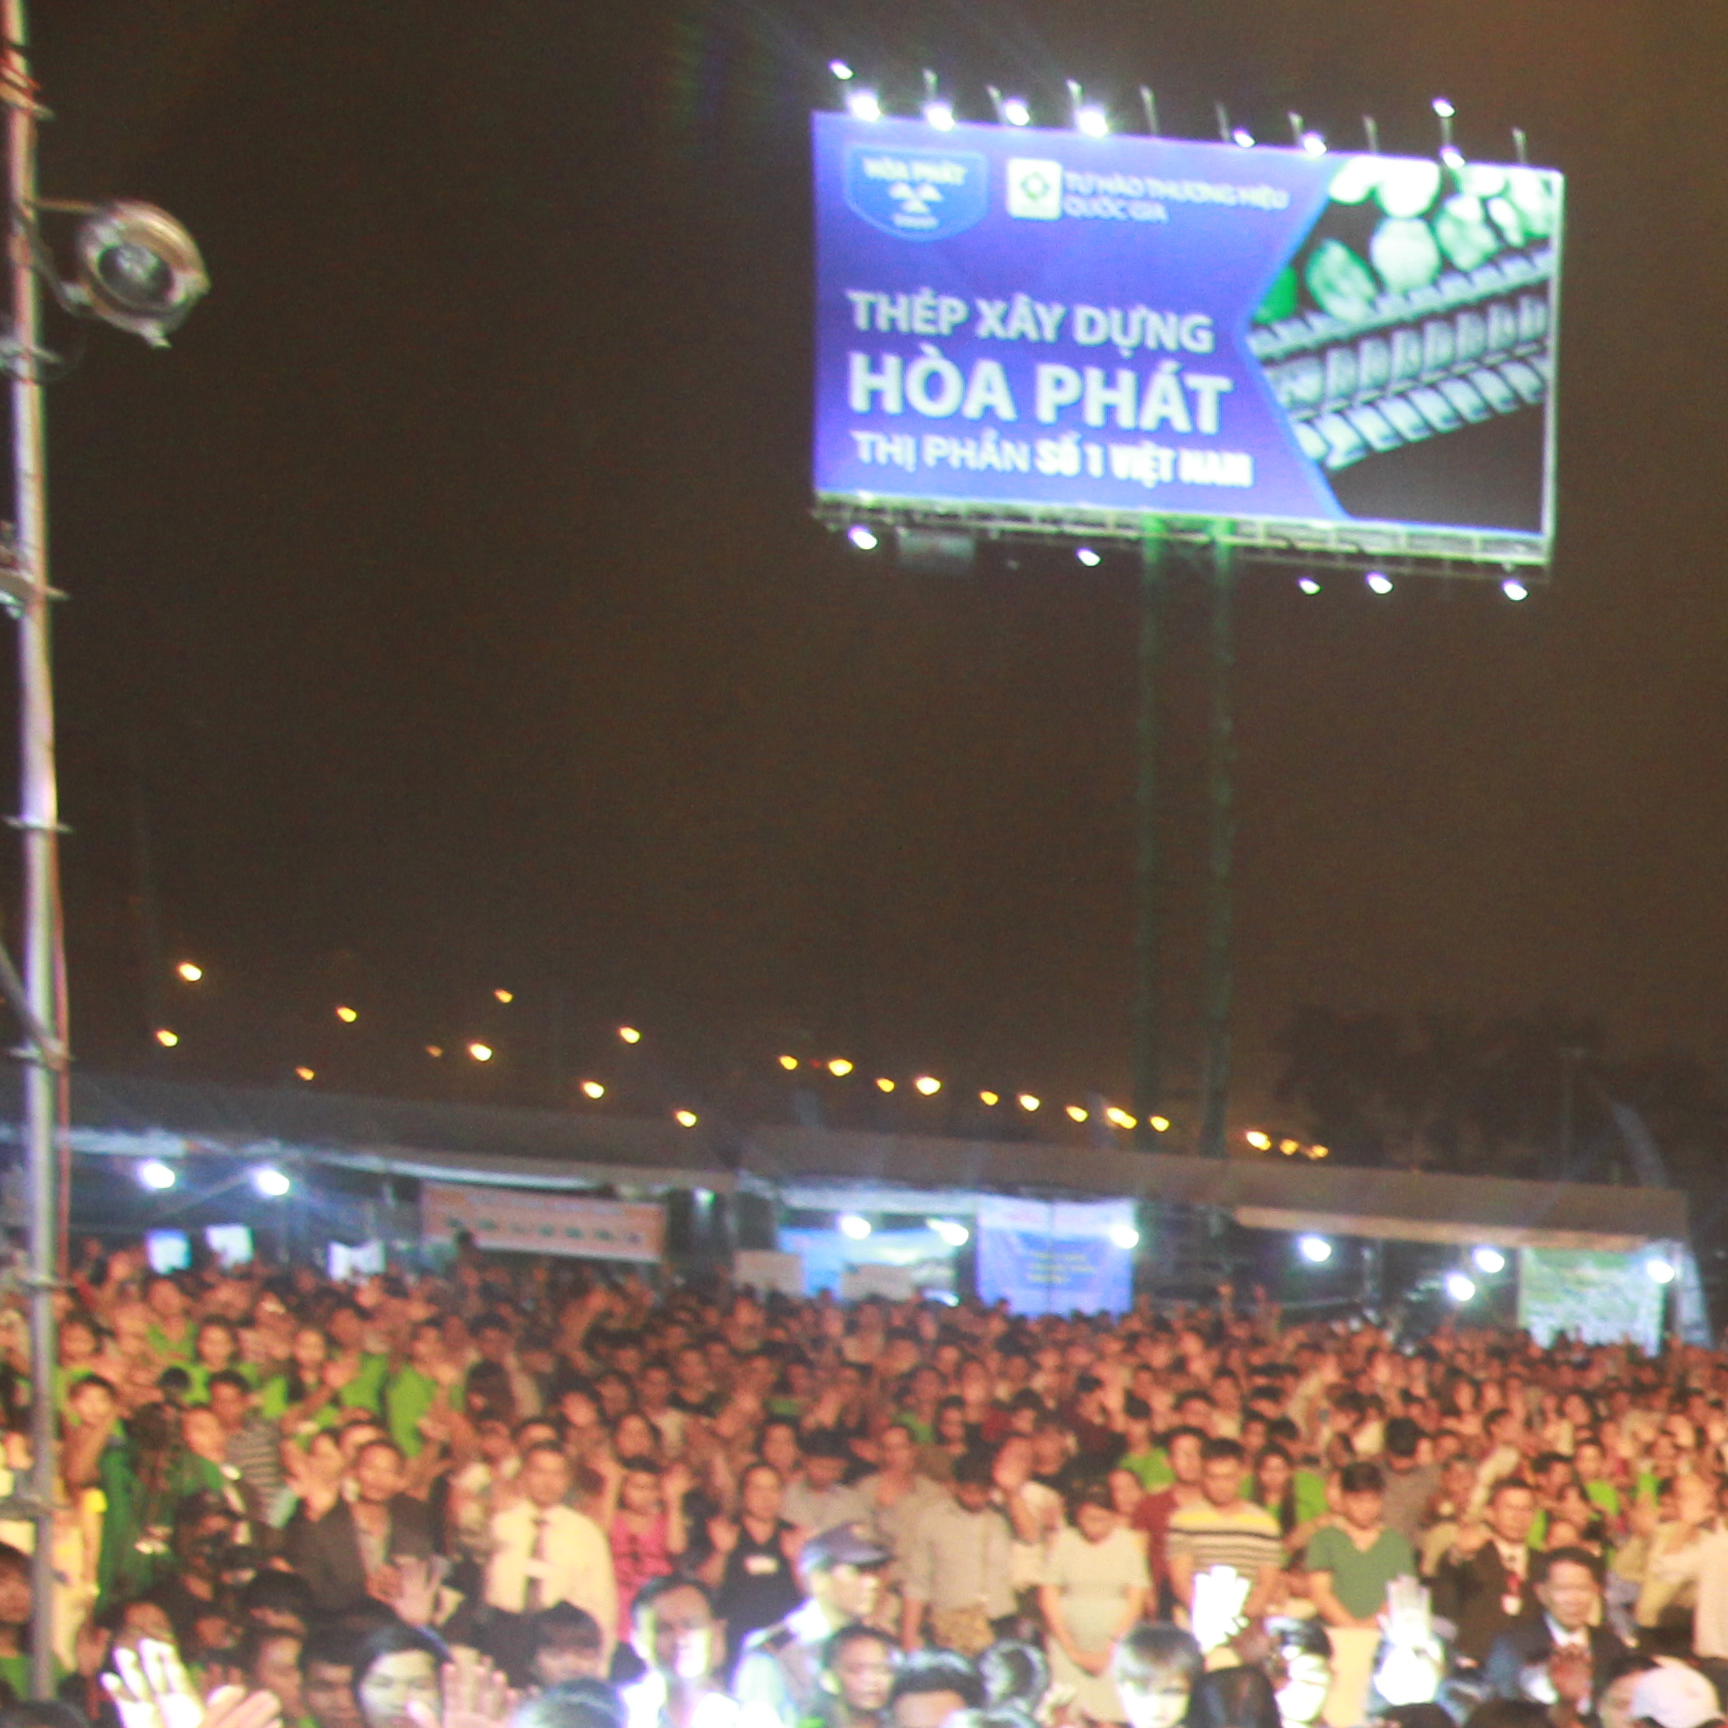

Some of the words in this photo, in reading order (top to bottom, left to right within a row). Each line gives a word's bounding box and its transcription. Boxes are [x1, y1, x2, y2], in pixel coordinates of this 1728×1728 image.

[846, 286, 969, 337] THÉP
[976, 292, 1067, 344] XÂY
[1073, 303, 1215, 358] DỰNG
[848, 342, 1018, 422] HÒA
[1034, 358, 1233, 435] PHÁT
[850, 429, 916, 472] THỊ
[923, 427, 1030, 473] PHẦN
[1034, 430, 1081, 477] SỐ
[1083, 443, 1104, 478] 1
[1106, 440, 1175, 489] VIỆT
[1177, 447, 1253, 489] NAM
